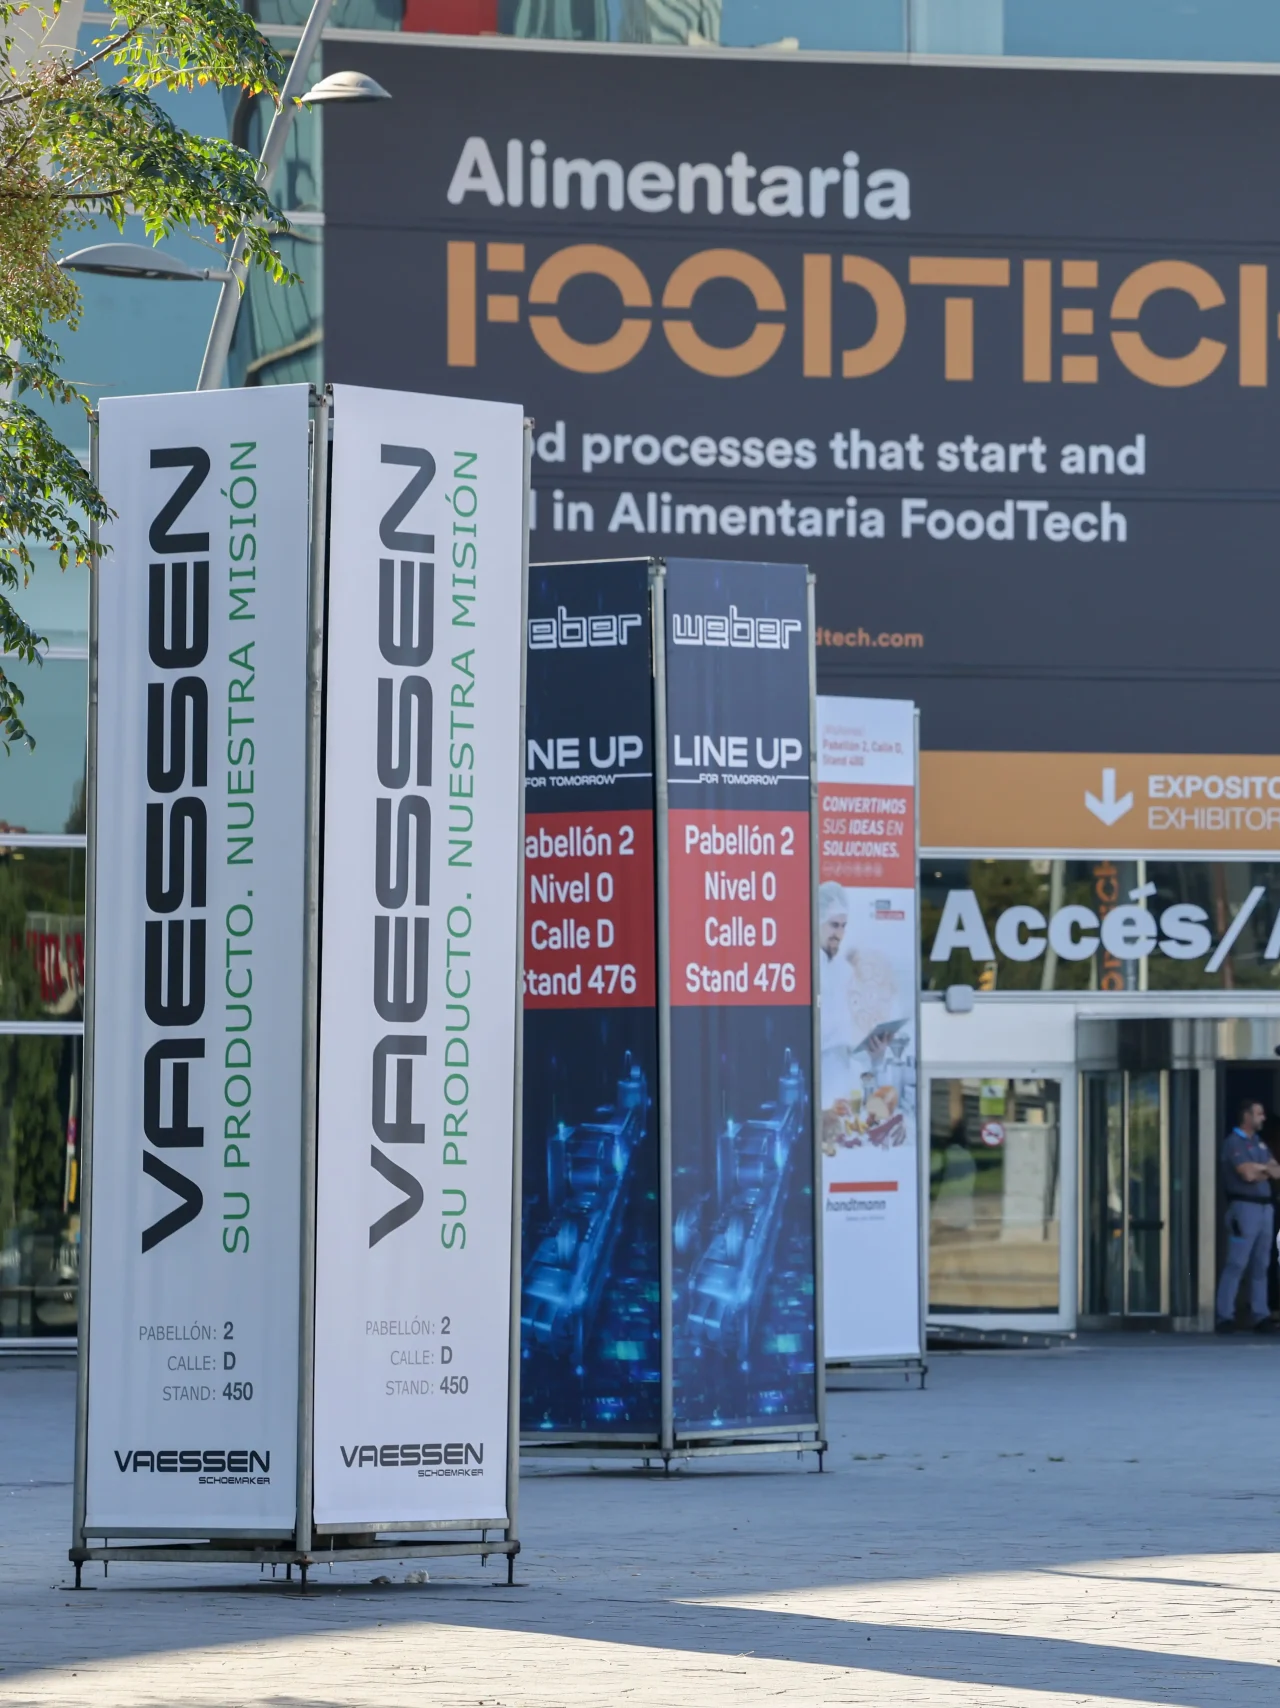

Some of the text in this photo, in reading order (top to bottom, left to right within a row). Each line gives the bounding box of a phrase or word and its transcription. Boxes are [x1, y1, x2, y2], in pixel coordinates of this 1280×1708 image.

[447, 136, 911, 221] Alimentaria
[582, 430, 818, 473] processes
[829, 428, 925, 471] that
[936, 434, 1048, 473] start
[1060, 433, 1147, 475] and
[552, 489, 595, 532] in
[607, 490, 886, 538] Alimentaria
[901, 498, 1128, 542] FoodTech
[527, 605, 643, 651] eber
[672, 604, 803, 650] weber
[815, 626, 925, 649] dtech.com
[526, 735, 644, 771] NE UP
[673, 734, 803, 769] LINE UP
[525, 773, 616, 789] FOR TOMORROW
[699, 772, 779, 786] FOR TOMORROW
[822, 796, 907, 815] CONVERTIMOS
[525, 825, 635, 859] abellón 2
[685, 824, 796, 856] Pabellón 2
[822, 818, 905, 837] SUS IDEAS EN
[141, 445, 212, 1255] VAESSEN
[220, 441, 258, 1254] SU PRODUCTO. NUESTRA MISIÓN
[369, 443, 437, 1250] VAESSEN
[440, 450, 479, 1250] SU PRODUCTO. NUESTRA MISIÓN
[822, 840, 901, 859] SOLUCIONES.
[530, 872, 590, 904] Nivel
[704, 870, 757, 901] Nivel
[530, 918, 614, 951] Calle D
[704, 916, 778, 948] Calle D
[587, 963, 637, 995] 476
[685, 962, 796, 993] Stand 476
[138, 1320, 235, 1342] PABELLÓN: 2
[365, 1315, 452, 1337] PABELLÓN: 2
[166, 1351, 237, 1372] CALLE: D
[389, 1345, 454, 1367] CALLE: D
[161, 1381, 254, 1402] STAND: 450
[384, 1375, 470, 1397] STAND: 450
[113, 1449, 271, 1474] VAESSEN
[339, 1442, 484, 1469] VAESSEN
[197, 1476, 271, 1486] SCHOEMAKER
[417, 1467, 484, 1478] SCHOEMAKER
